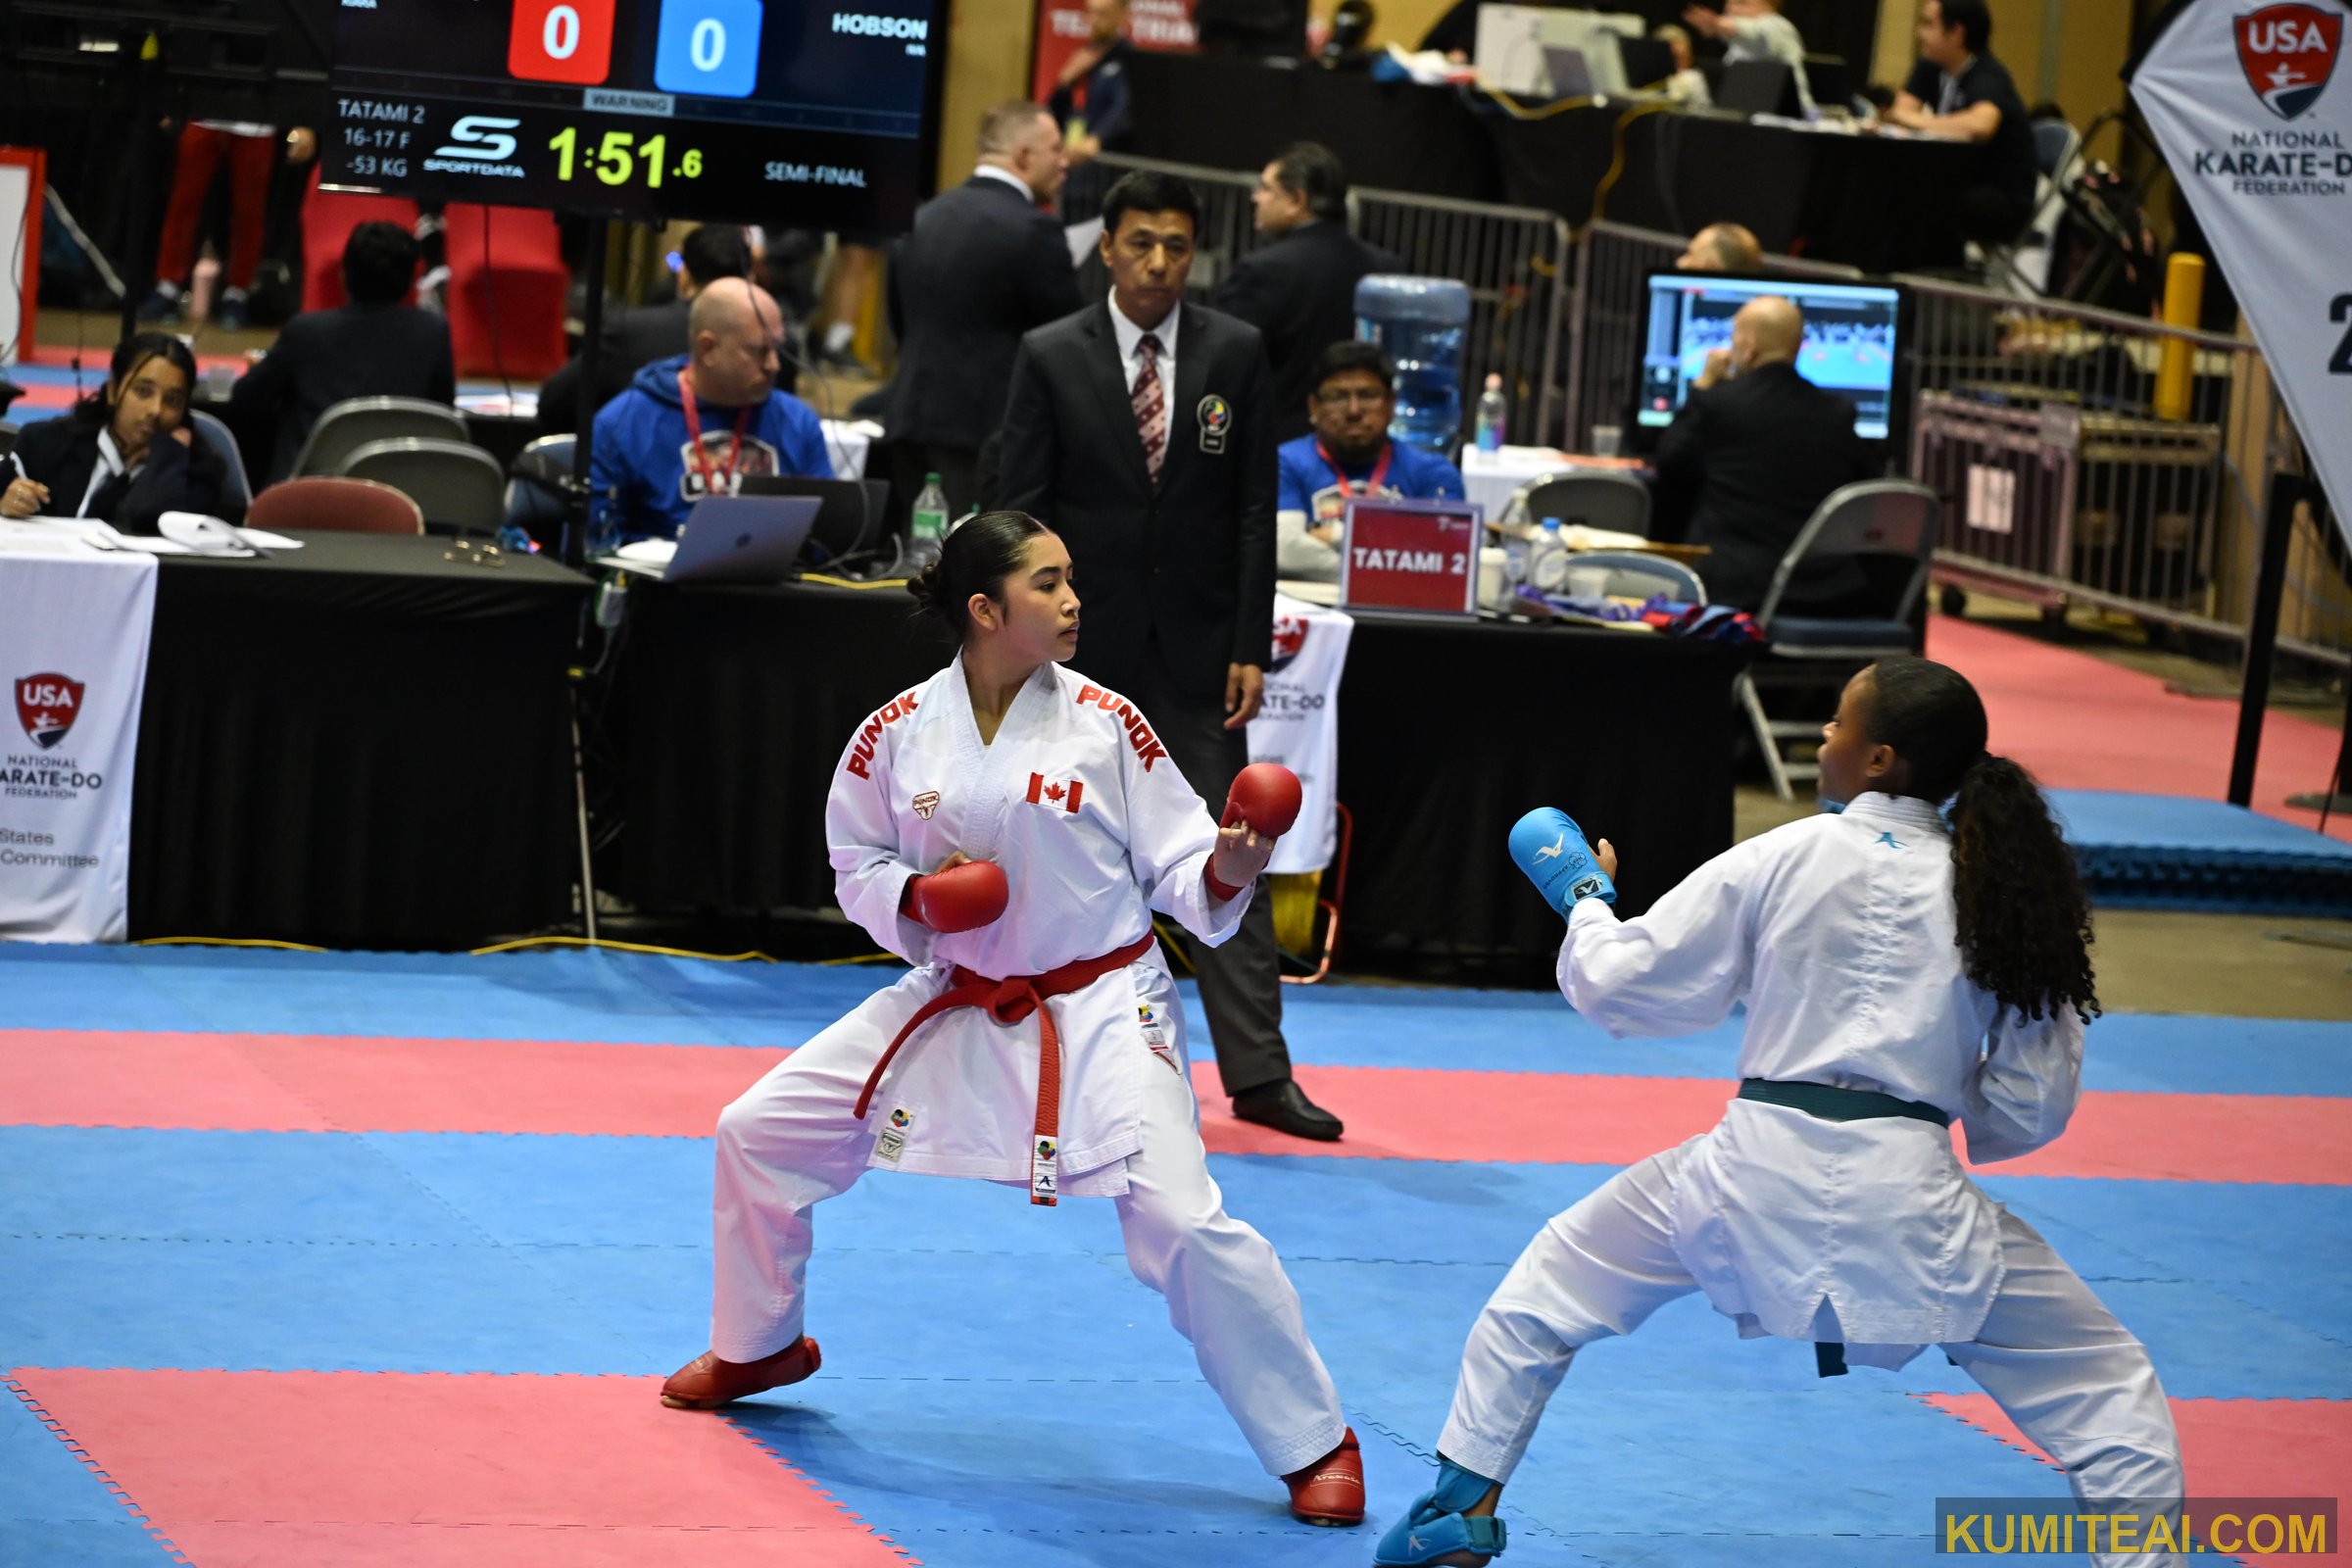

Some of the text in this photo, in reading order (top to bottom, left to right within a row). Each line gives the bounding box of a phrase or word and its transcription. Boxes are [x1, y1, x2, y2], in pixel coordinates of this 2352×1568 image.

[543, 5, 579, 60] 0
[831, 12, 928, 40] HOBSON
[2248, 21, 2328, 54] USA
[690, 18, 727, 72] 0
[338, 99, 425, 124] TATAMI 2
[591, 94, 668, 112] WARNING
[344, 127, 412, 150] 16-17 F
[2231, 130, 2345, 149] NATIONAL
[346, 154, 408, 177] -53 KG
[422, 158, 525, 178] SPORTDATA
[764, 161, 867, 188] SEMI-FINAL
[2194, 150, 2352, 177] KARATE-D
[2232, 178, 2346, 196] FEDERATION
[1352, 548, 1466, 575] TATAMI 2
[23, 682, 74, 709] USA
[846, 691, 919, 781] PUNOK
[1075, 683, 1168, 773] PUNOK
[8, 755, 78, 768] NATIONAL
[0, 768, 103, 791] ARATE-DO
[5, 787, 77, 801] FEDERATION
[0, 849, 100, 868] Committee
